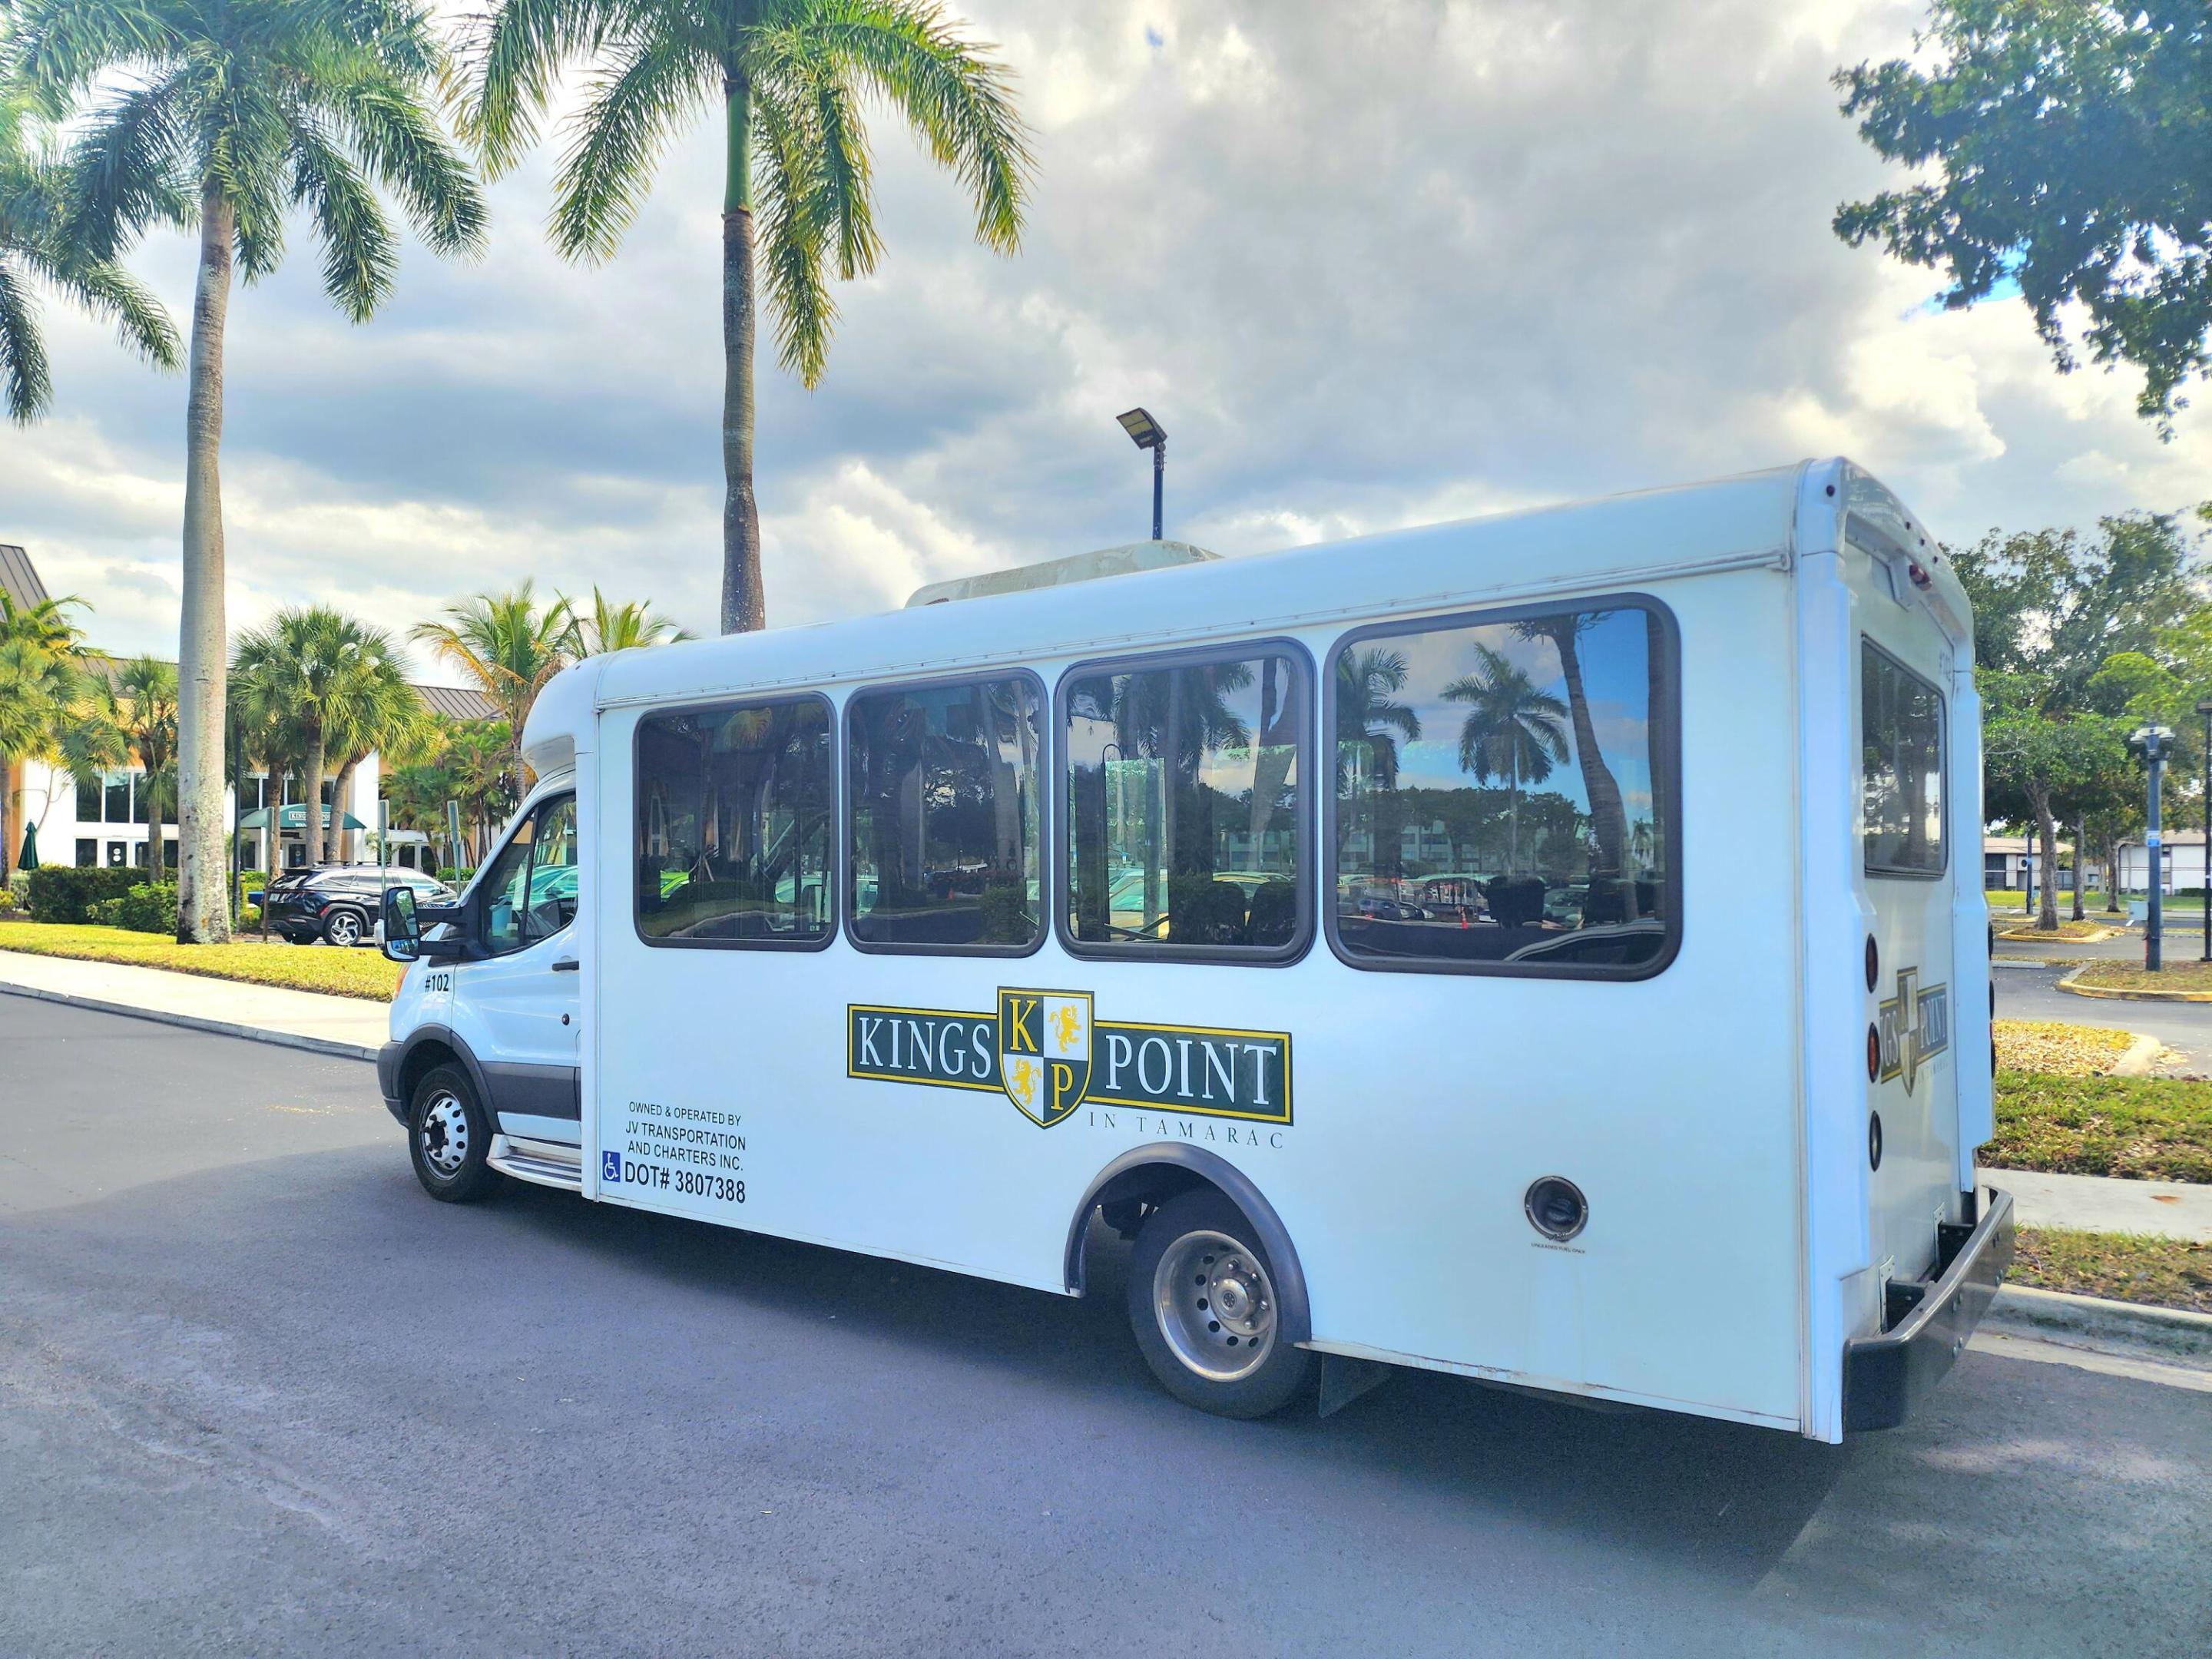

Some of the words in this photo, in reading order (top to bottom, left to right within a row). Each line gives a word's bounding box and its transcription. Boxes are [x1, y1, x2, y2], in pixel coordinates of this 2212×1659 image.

[425, 973, 449, 992] #102
[1009, 998, 1038, 1052] K
[859, 1016, 992, 1078] KINGS
[1051, 1063, 1074, 1111] P
[1106, 1035, 1278, 1105] POINT
[629, 1101, 662, 1116] OWNED
[665, 1106, 671, 1118] &
[674, 1107, 725, 1124] OPERATED
[728, 1114, 741, 1127] BY
[1089, 1111, 1116, 1128] IN
[1136, 1116, 1283, 1149] TAMARAC
[625, 1121, 638, 1134] JV
[641, 1122, 746, 1151] TRANSPORTATION
[628, 1141, 651, 1156] AND
[654, 1144, 716, 1167] CHARTERS
[720, 1154, 743, 1171] INC.
[624, 1161, 670, 1190] DOT#
[675, 1170, 746, 1204] 3807388
